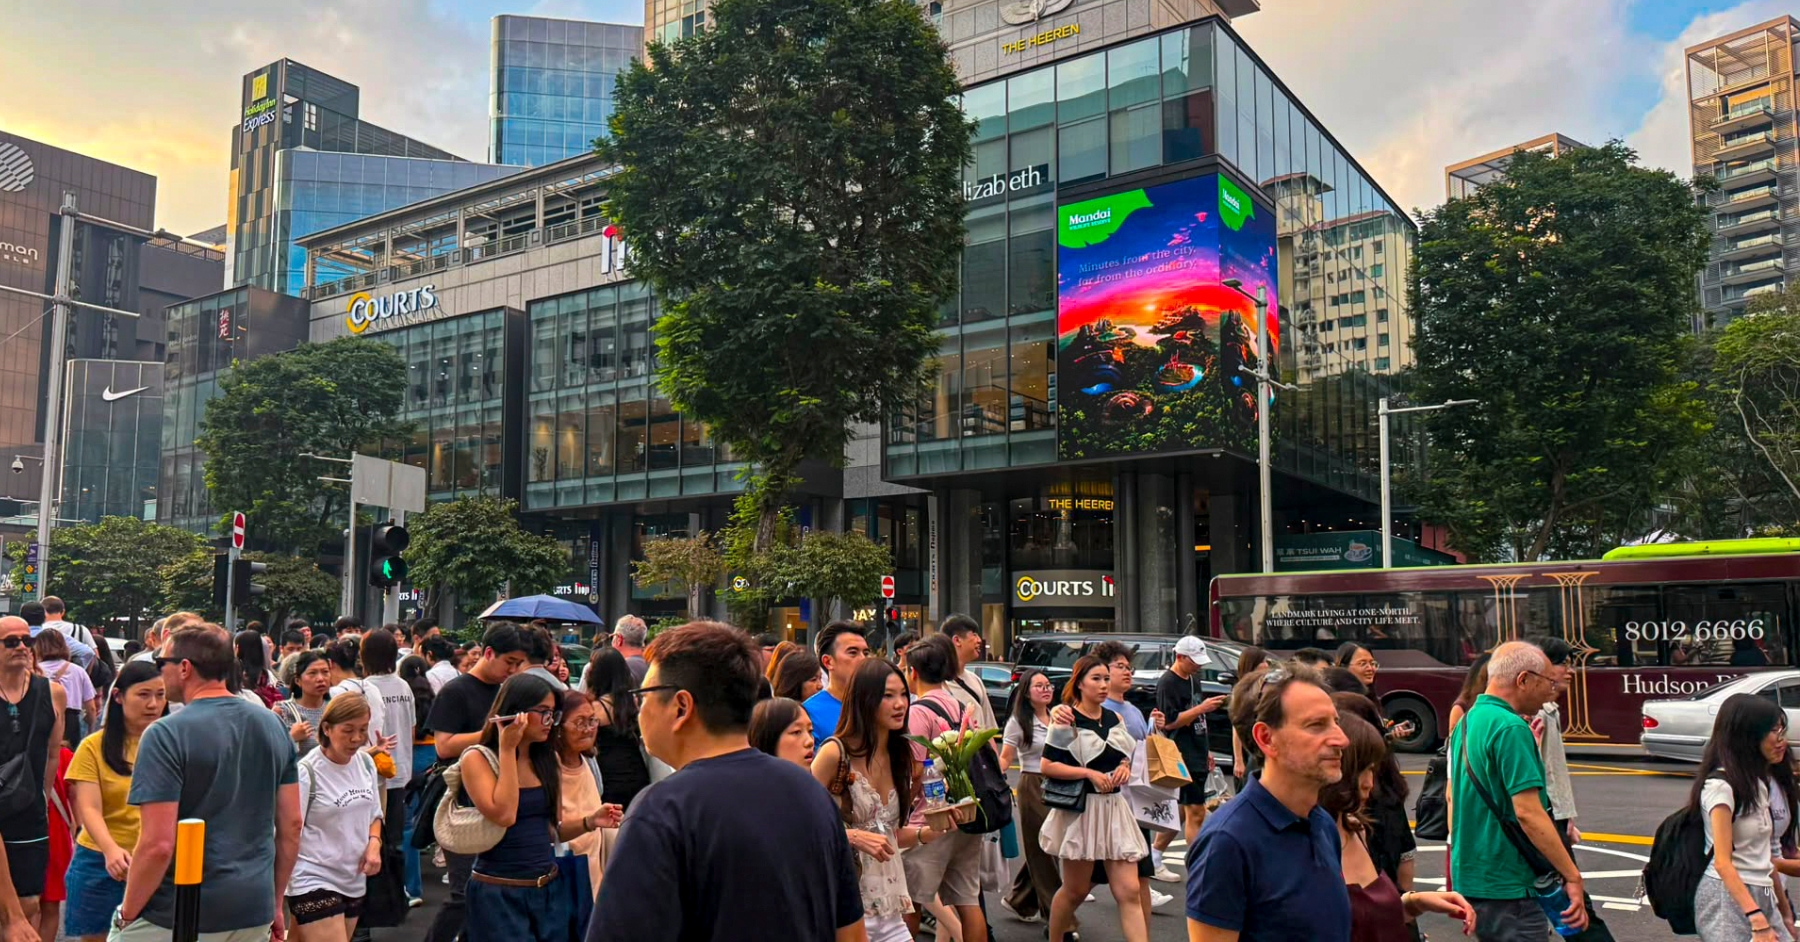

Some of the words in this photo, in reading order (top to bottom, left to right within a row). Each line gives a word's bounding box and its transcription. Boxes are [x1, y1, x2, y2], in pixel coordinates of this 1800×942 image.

[1002, 38, 1027, 56] THE
[1028, 23, 1080, 49] HEEREN
[244, 110, 277, 132] Express
[962, 164, 1041, 201] lizabeth
[1069, 207, 1111, 226] Mandai
[1079, 259, 1120, 273] Minutes
[1123, 253, 1150, 265] from
[1152, 249, 1170, 260] the
[1078, 277, 1093, 287] far
[1095, 273, 1122, 285] from
[1125, 268, 1143, 279] the
[347, 285, 437, 332] COURTS
[1049, 499, 1072, 509] THE
[1018, 577, 1094, 600] COURTS
[1265, 619, 1294, 628] WHERE
[1295, 618, 1333, 627] CULTURE
[1335, 618, 1352, 626] AND
[1353, 617, 1373, 625] CITY
[1374, 616, 1393, 625] LIFE
[1271, 610, 1316, 620] LANDMARK
[1317, 609, 1344, 618] LIVING
[1345, 609, 1356, 617] AT
[1625, 621, 1688, 641] 8012
[1694, 619, 1764, 641] 6666
[1621, 674, 1709, 695] Hudson
